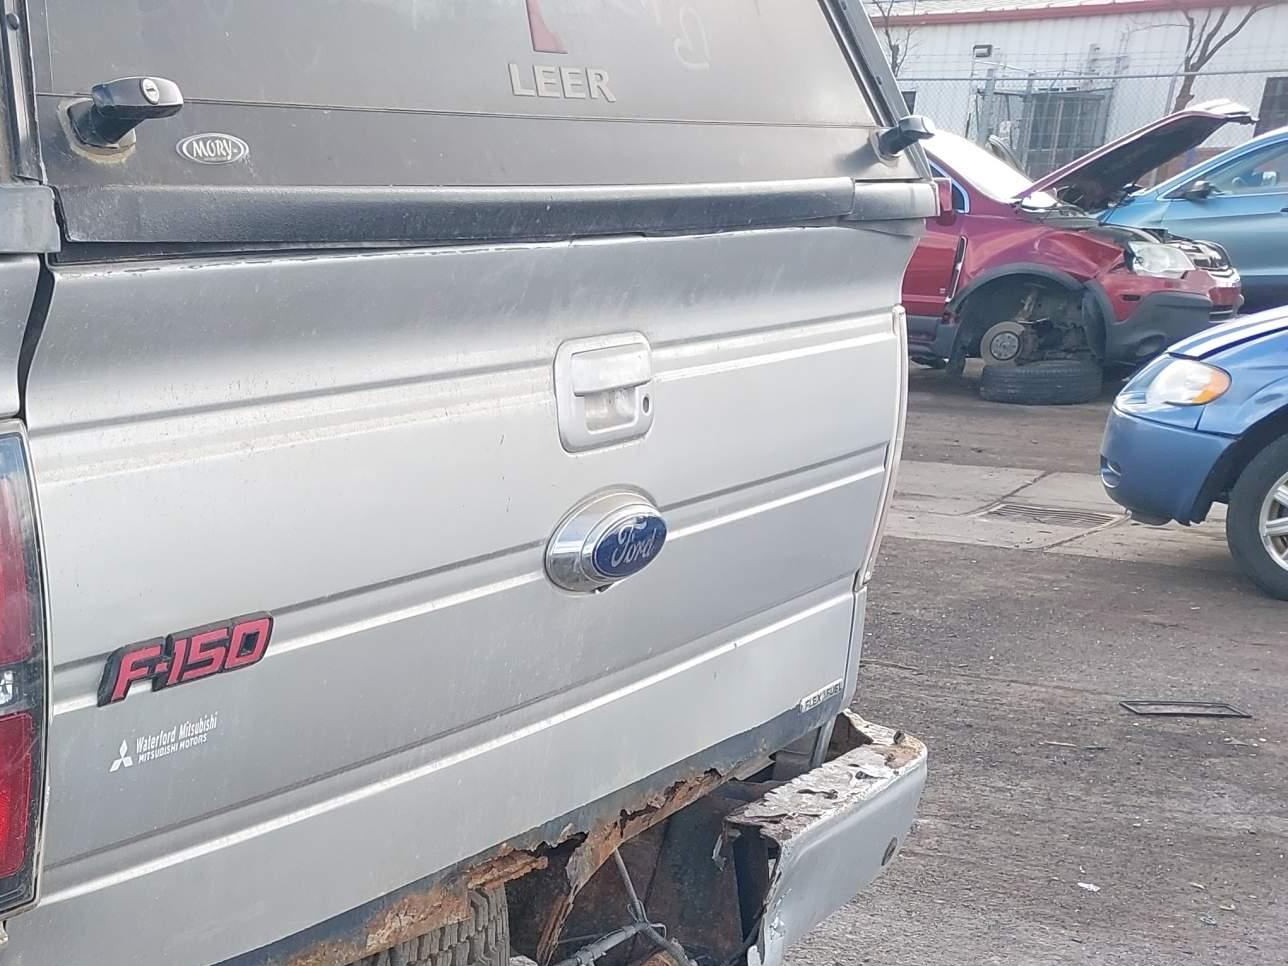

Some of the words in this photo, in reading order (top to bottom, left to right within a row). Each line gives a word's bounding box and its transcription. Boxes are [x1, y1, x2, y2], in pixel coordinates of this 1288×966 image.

[508, 62, 616, 103] LEER
[611, 515, 657, 568] Ford
[97, 611, 274, 707] F-150
[137, 726, 176, 753] Waterford
[179, 711, 218, 740] Mitsubishi
[179, 732, 207, 750] MOTORS
